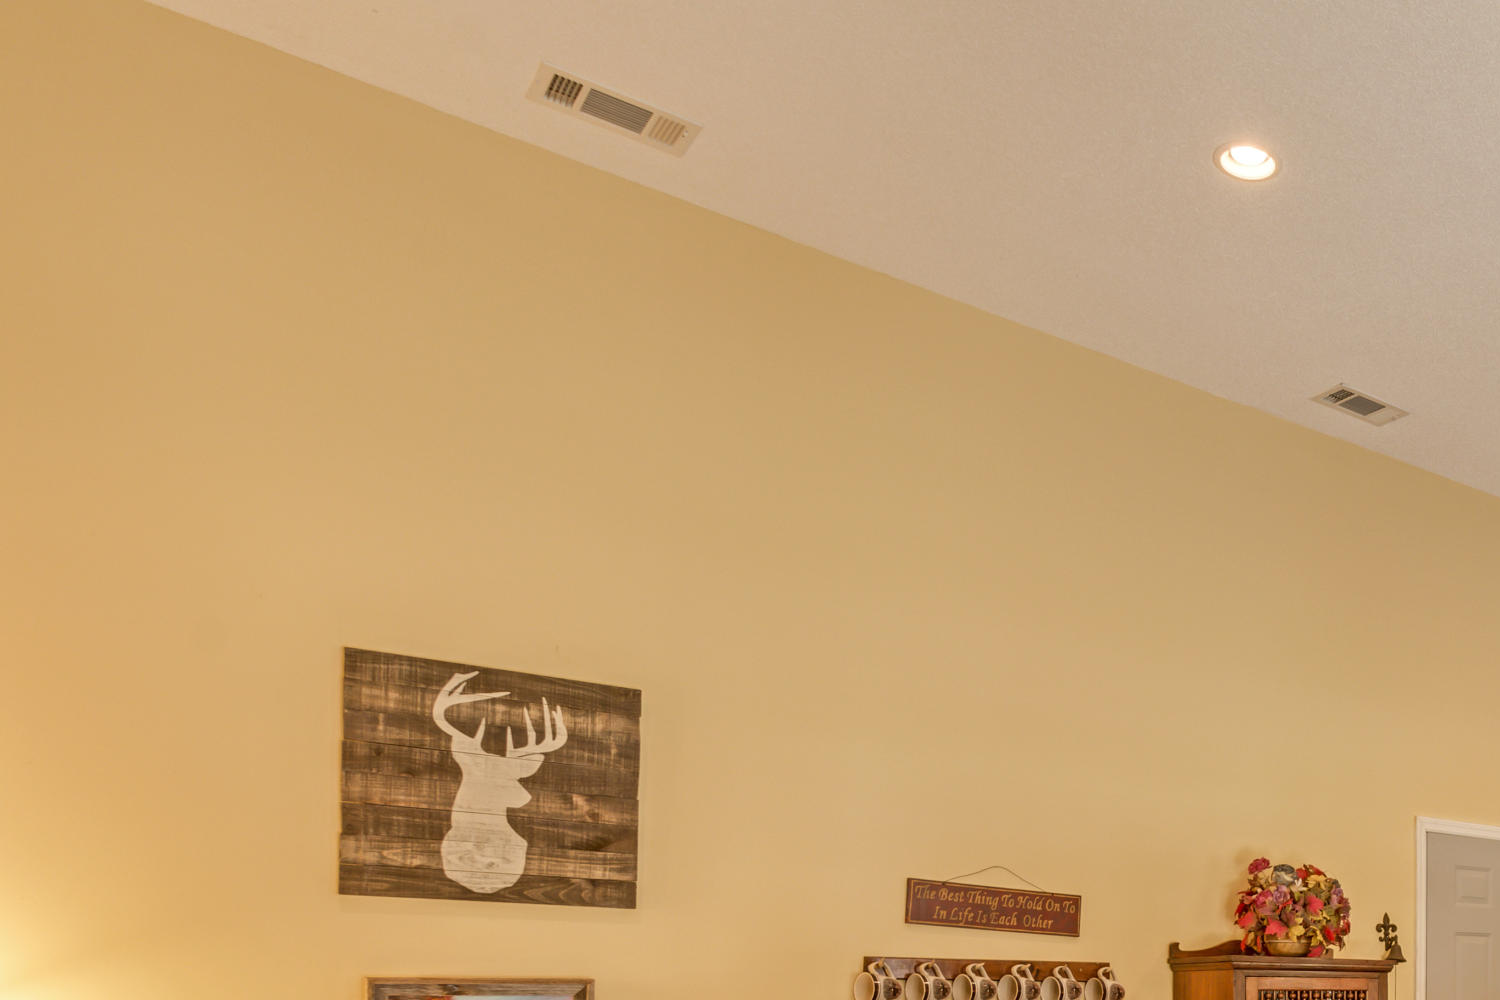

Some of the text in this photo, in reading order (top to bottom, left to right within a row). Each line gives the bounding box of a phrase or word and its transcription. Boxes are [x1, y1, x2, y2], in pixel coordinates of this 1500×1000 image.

[915, 885, 1076, 914] The Best Thing To Hold On To
[932, 905, 1054, 929] In Life Is Each Other
